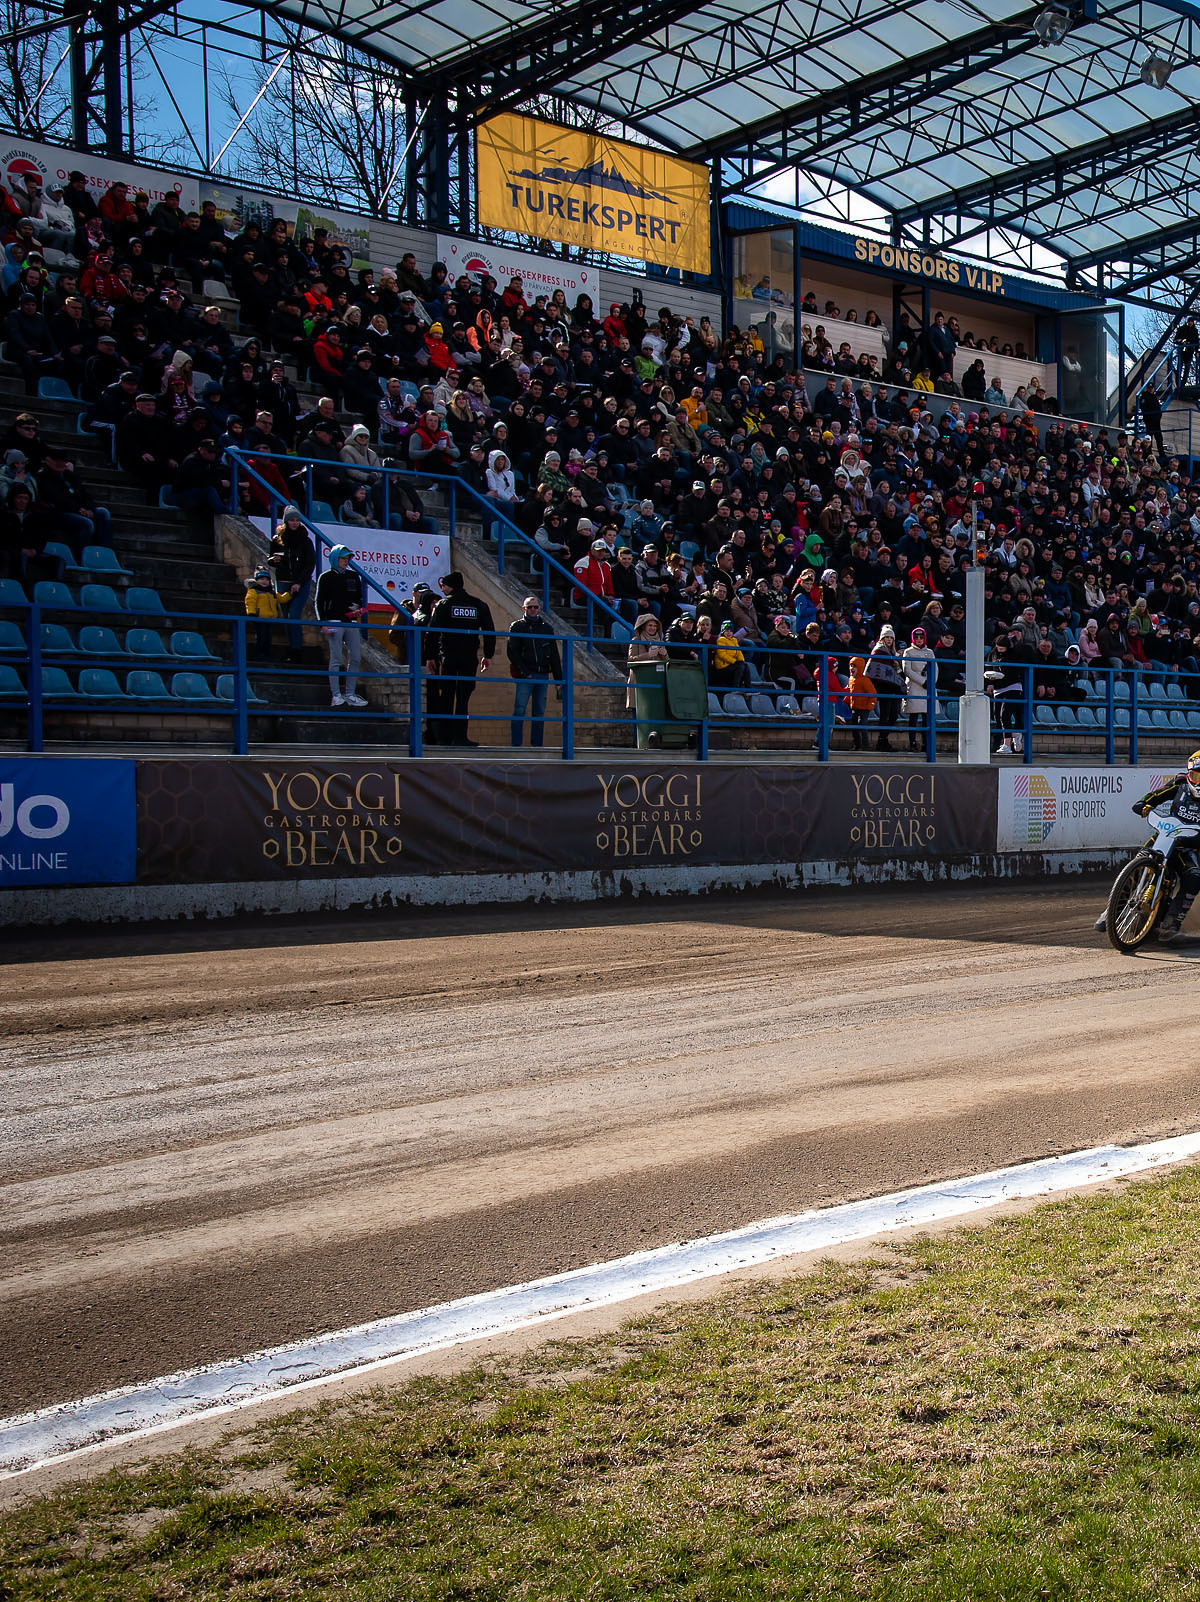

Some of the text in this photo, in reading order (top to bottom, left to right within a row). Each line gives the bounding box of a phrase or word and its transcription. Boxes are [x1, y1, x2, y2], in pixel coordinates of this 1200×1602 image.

[37, 160, 48, 174] LTD
[148, 189, 167, 202] LTD
[506, 182, 681, 244] TUREKSPERT
[551, 226, 651, 256] TRAVEL AGENCY
[498, 265, 560, 286] OLEGSEXPRESS
[563, 278, 576, 289] LTD
[854, 238, 1005, 295] SPONSORS V.I.P.
[411, 556, 430, 567] LTD
[454, 608, 476, 617] GROM
[263, 772, 402, 812] YOGGI
[596, 774, 702, 808] YOGGI
[850, 774, 936, 805] YOGGI
[1060, 776, 1123, 794] DAUGAVPILS
[264, 812, 402, 828] GASTROBĀRS
[598, 808, 702, 822] GASTROBĀRS
[851, 806, 935, 818] GASTROBĀRS
[1060, 800, 1106, 818] IR SPORTS
[614, 823, 692, 857] BEAR
[864, 820, 926, 848] BEAR
[286, 828, 385, 867] BEAR
